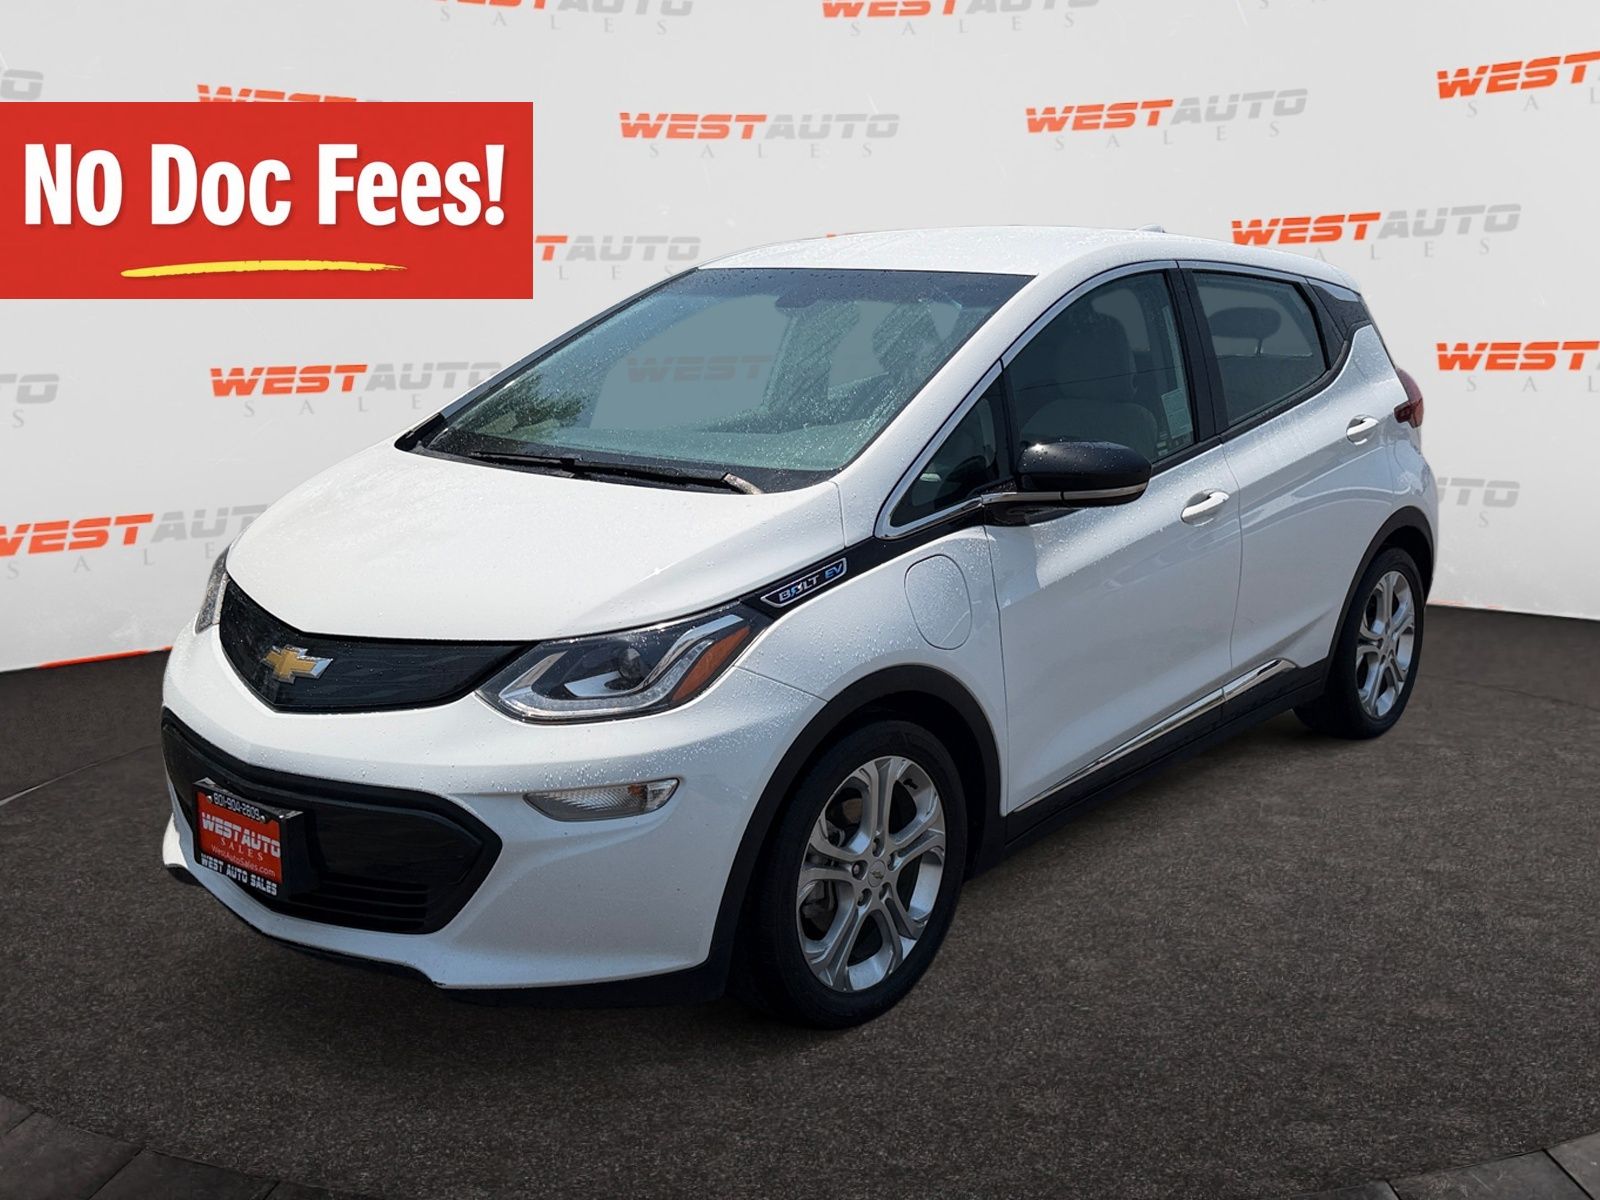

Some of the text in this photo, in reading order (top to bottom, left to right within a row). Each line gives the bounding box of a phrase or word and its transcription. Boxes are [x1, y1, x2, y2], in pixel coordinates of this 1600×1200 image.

[440, 6, 668, 35] SALES
[850, 12, 1075, 36] SALES
[1437, 51, 1600, 99] WEST
[649, 143, 873, 159] SALES
[1055, 121, 1280, 151] SALES
[1436, 341, 1600, 371] WEST
[779, 563, 843, 601] BOLT EV
[221, 838, 264, 861] SALES
[201, 852, 277, 896] WEST AUTO SALES
